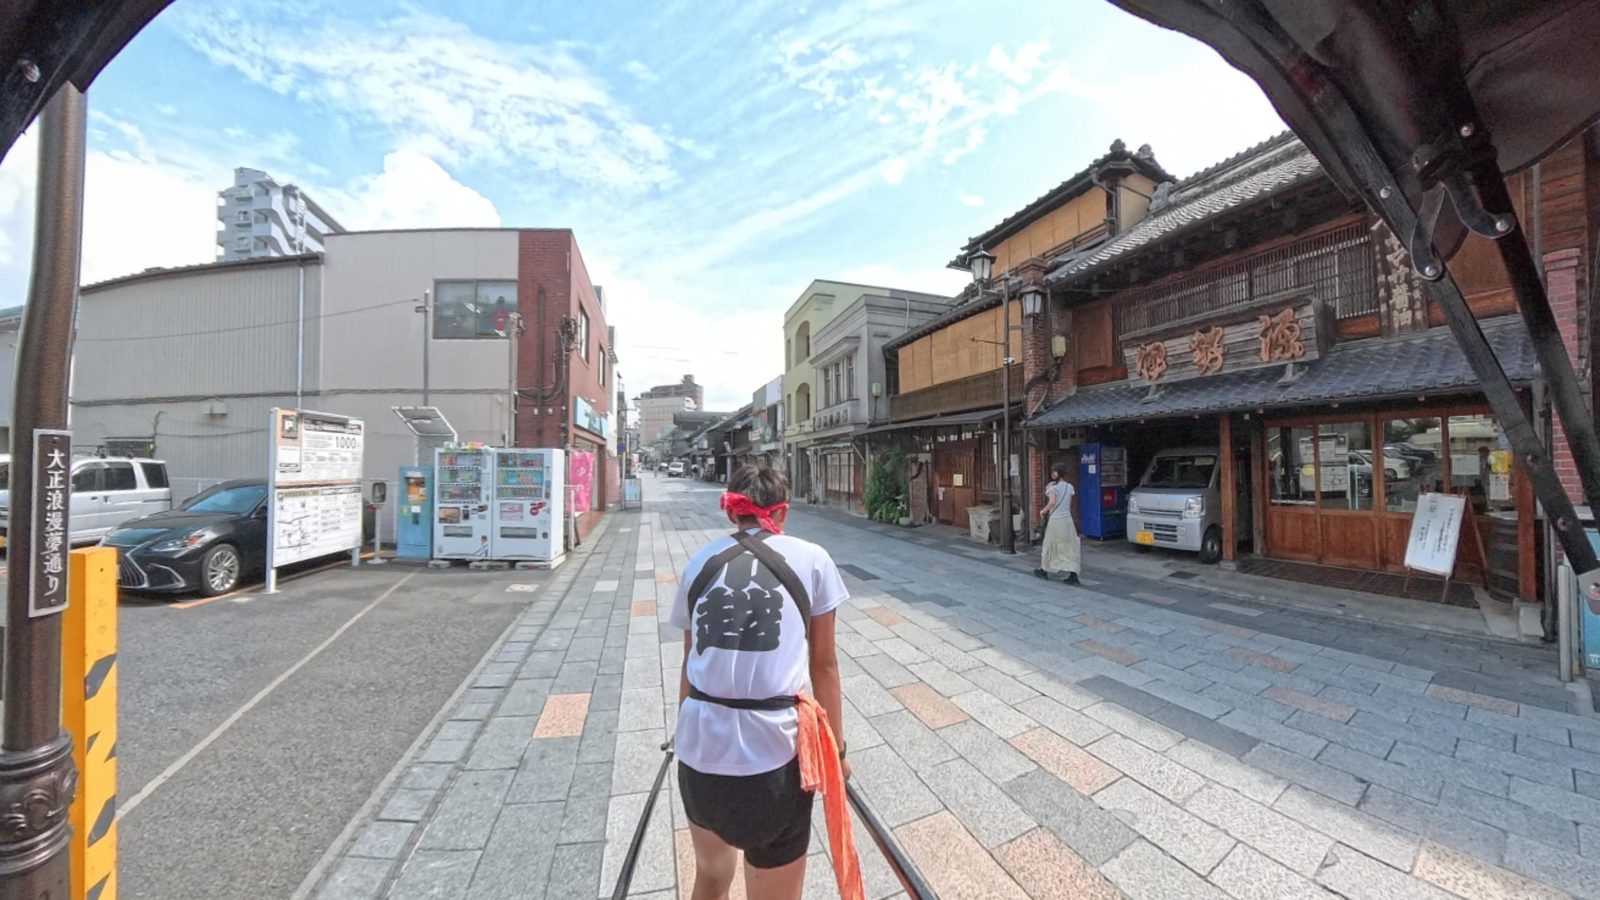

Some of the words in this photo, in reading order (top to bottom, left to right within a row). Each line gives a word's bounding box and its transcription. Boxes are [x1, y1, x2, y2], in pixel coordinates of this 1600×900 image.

[40, 448, 66, 596] 大正浪漫夢通り
